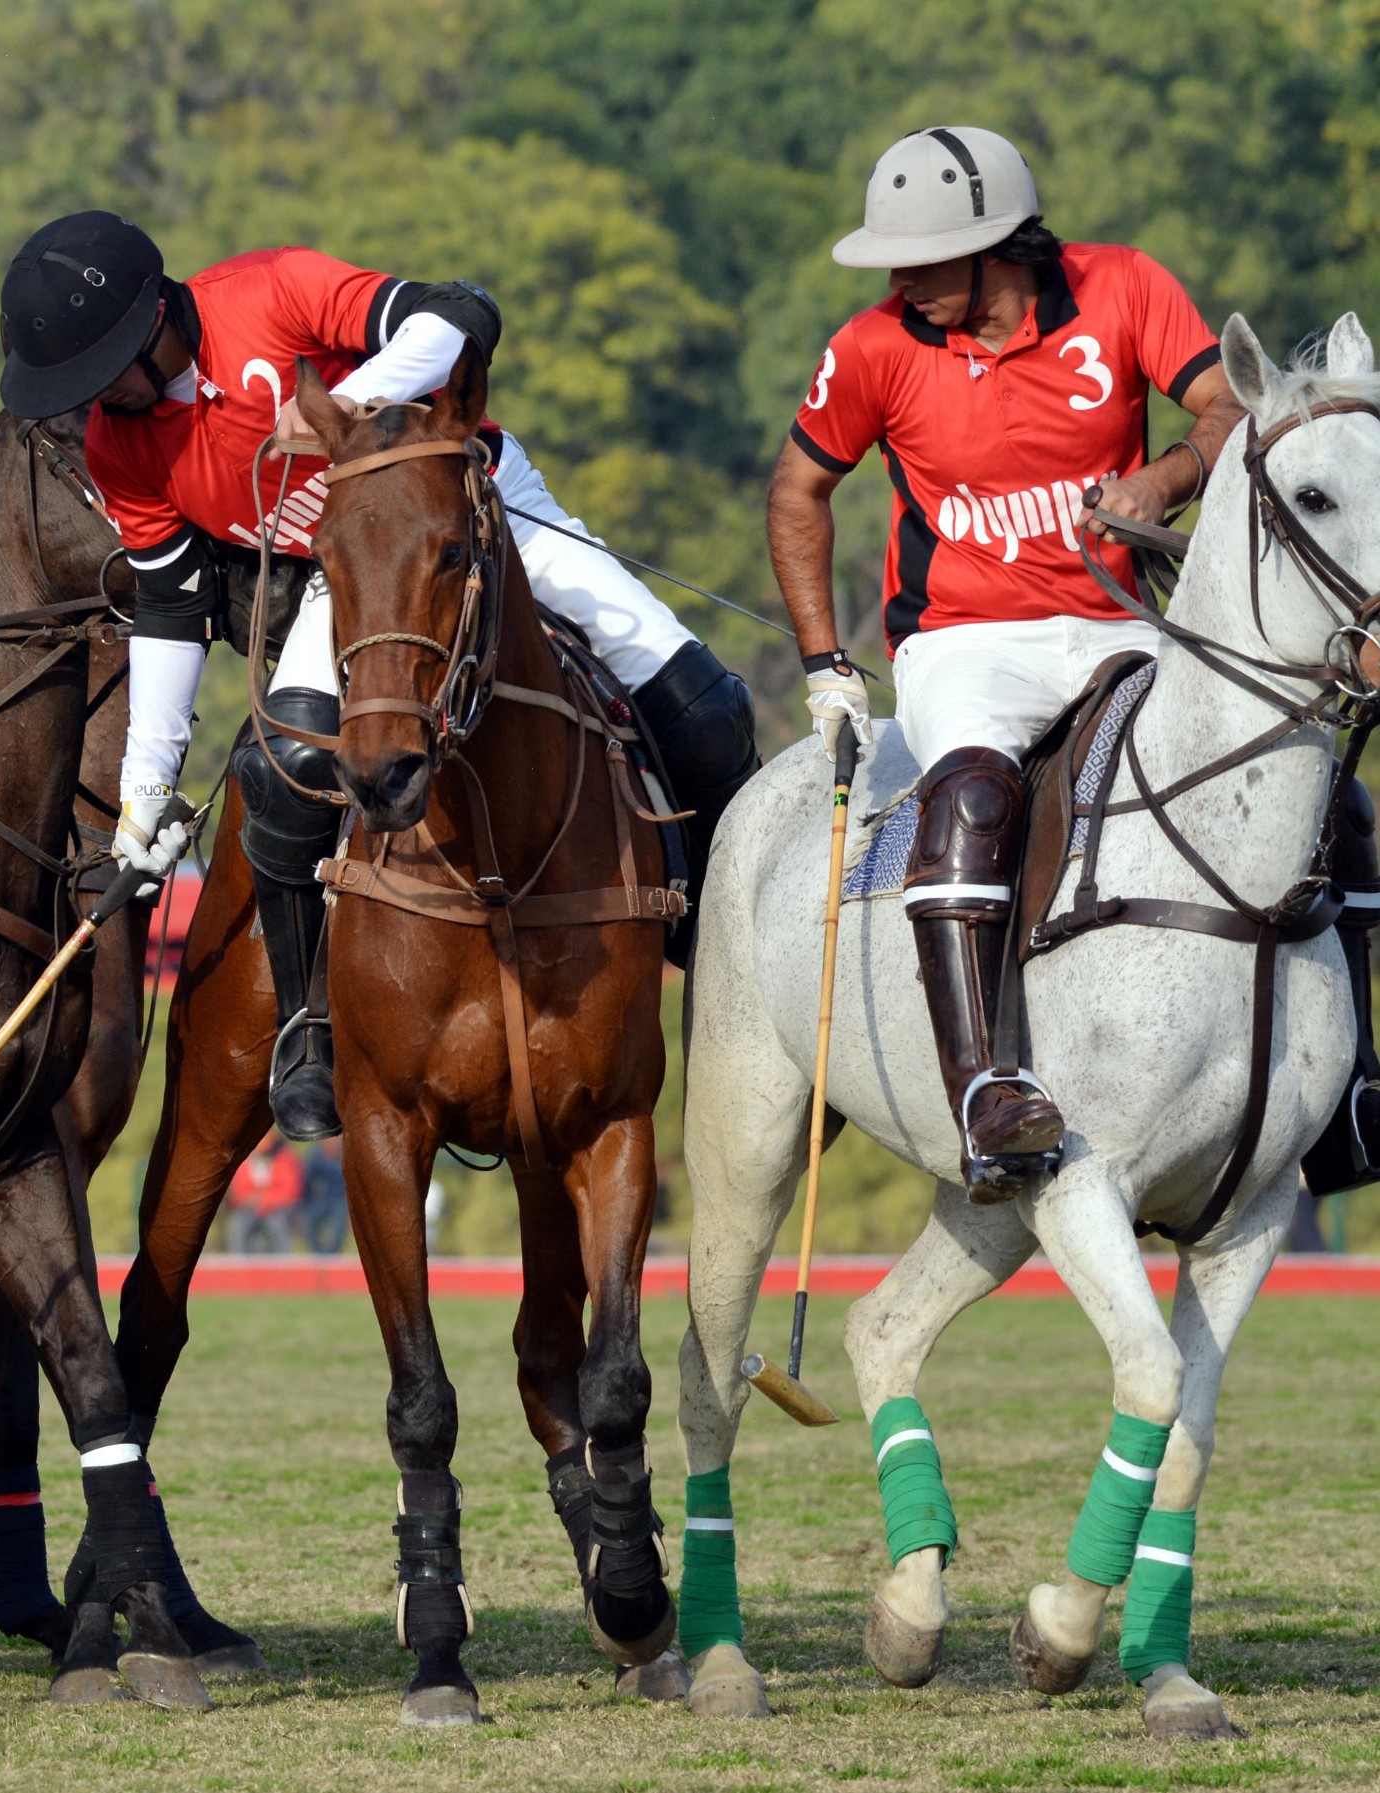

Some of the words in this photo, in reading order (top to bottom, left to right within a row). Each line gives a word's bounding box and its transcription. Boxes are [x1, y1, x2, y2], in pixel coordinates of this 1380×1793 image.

[805, 347, 835, 409] 3
[1058, 335, 1113, 410] 3
[938, 470, 1118, 563] olymp
